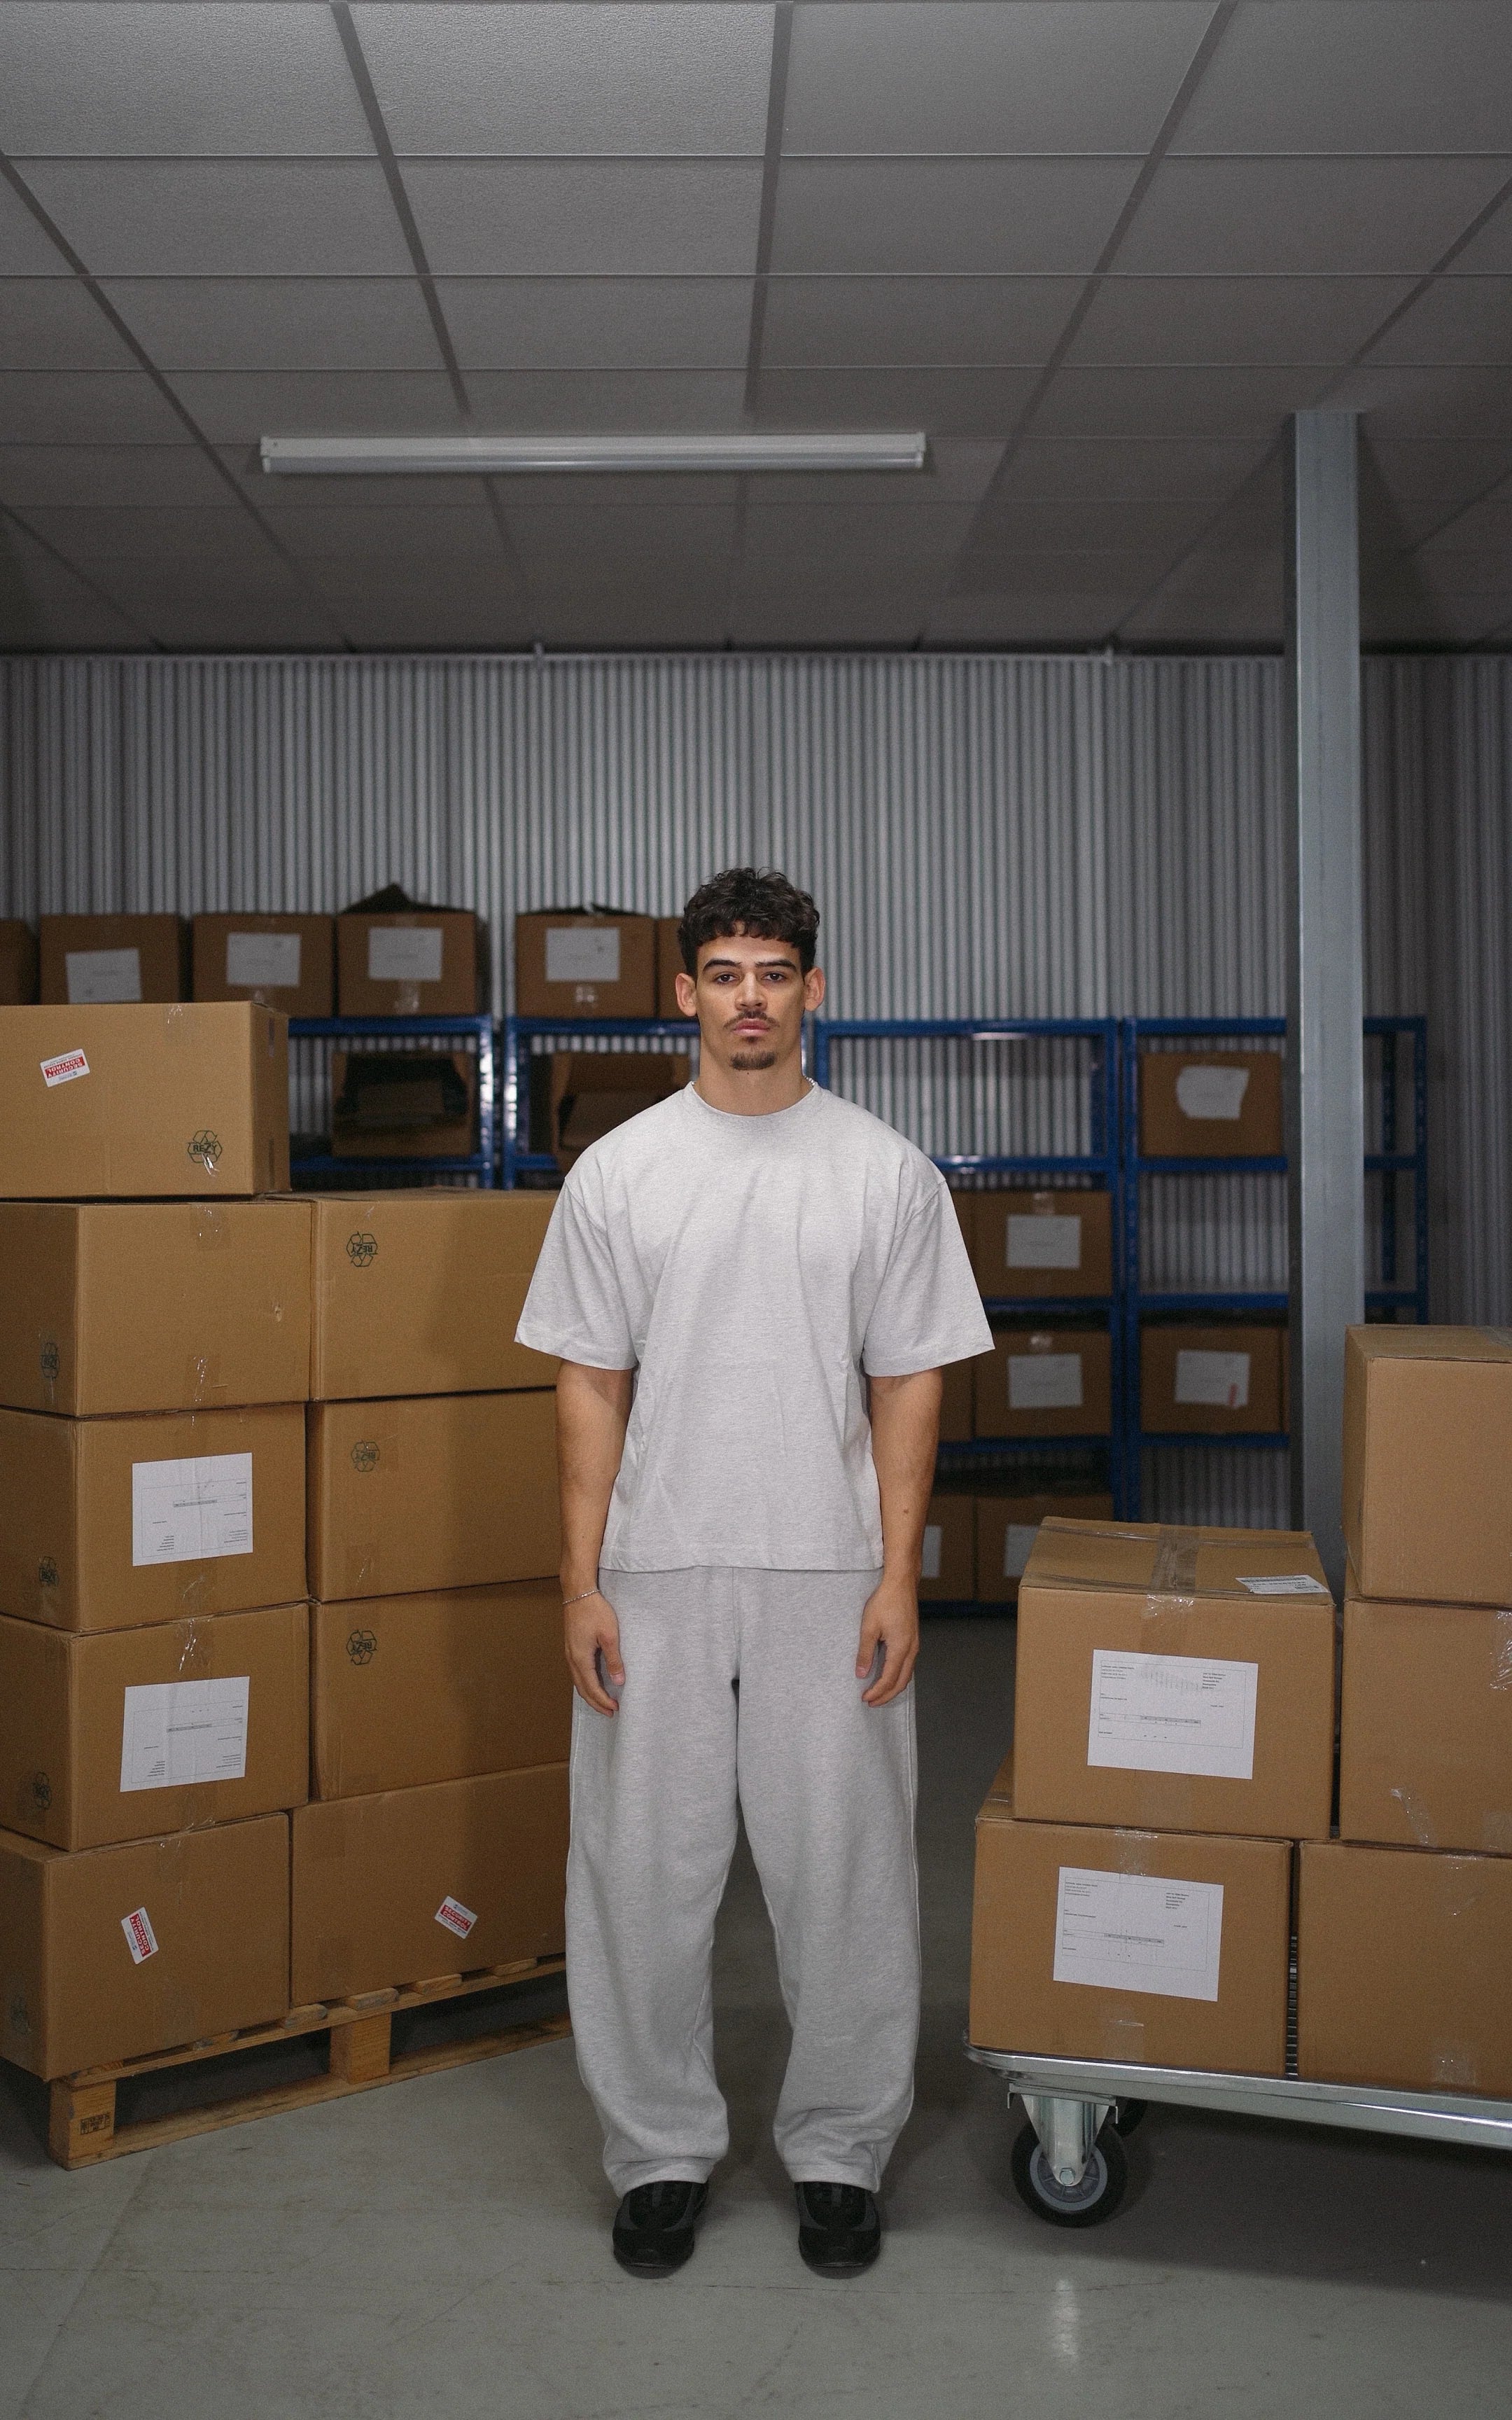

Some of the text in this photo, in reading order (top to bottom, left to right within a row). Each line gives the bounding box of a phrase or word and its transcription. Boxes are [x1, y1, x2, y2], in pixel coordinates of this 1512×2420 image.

[46, 1058, 80, 1073] CONTROL
[48, 1063, 83, 1078] SECURITY
[193, 1142, 217, 1154] REZY
[351, 1244, 373, 1254] REZY
[130, 1919, 146, 1955] SECURITY
[135, 1915, 150, 1951] CONTROL
